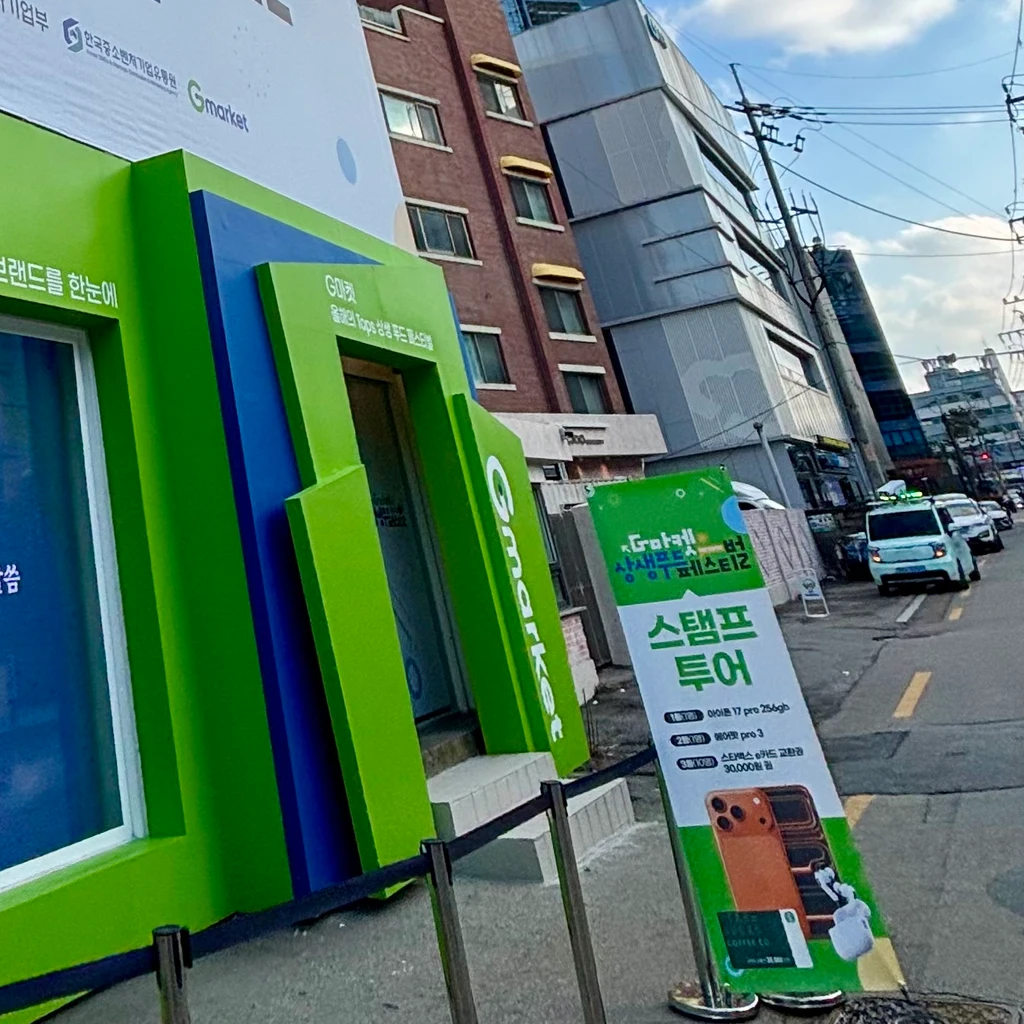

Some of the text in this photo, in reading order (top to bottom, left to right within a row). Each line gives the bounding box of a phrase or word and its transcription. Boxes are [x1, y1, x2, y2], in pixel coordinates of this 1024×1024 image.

[83, 30, 178, 90] 한국중소벤처기업유통원
[187, 79, 250, 133] Gmarket
[66, 271, 118, 309] 한눈에
[325, 274, 357, 305] G마켓
[376, 318, 393, 339] 상생
[392, 323, 409, 343] 푸드
[628, 528, 697, 557] G마켓
[614, 549, 689, 584] 상생푸드
[486, 455, 564, 743] Gmarket
[648, 605, 758, 649] 스탬프
[674, 649, 753, 692] 투어
[743, 706, 759, 718] pro
[740, 730, 756, 742] pro
[756, 728, 764, 738] 3
